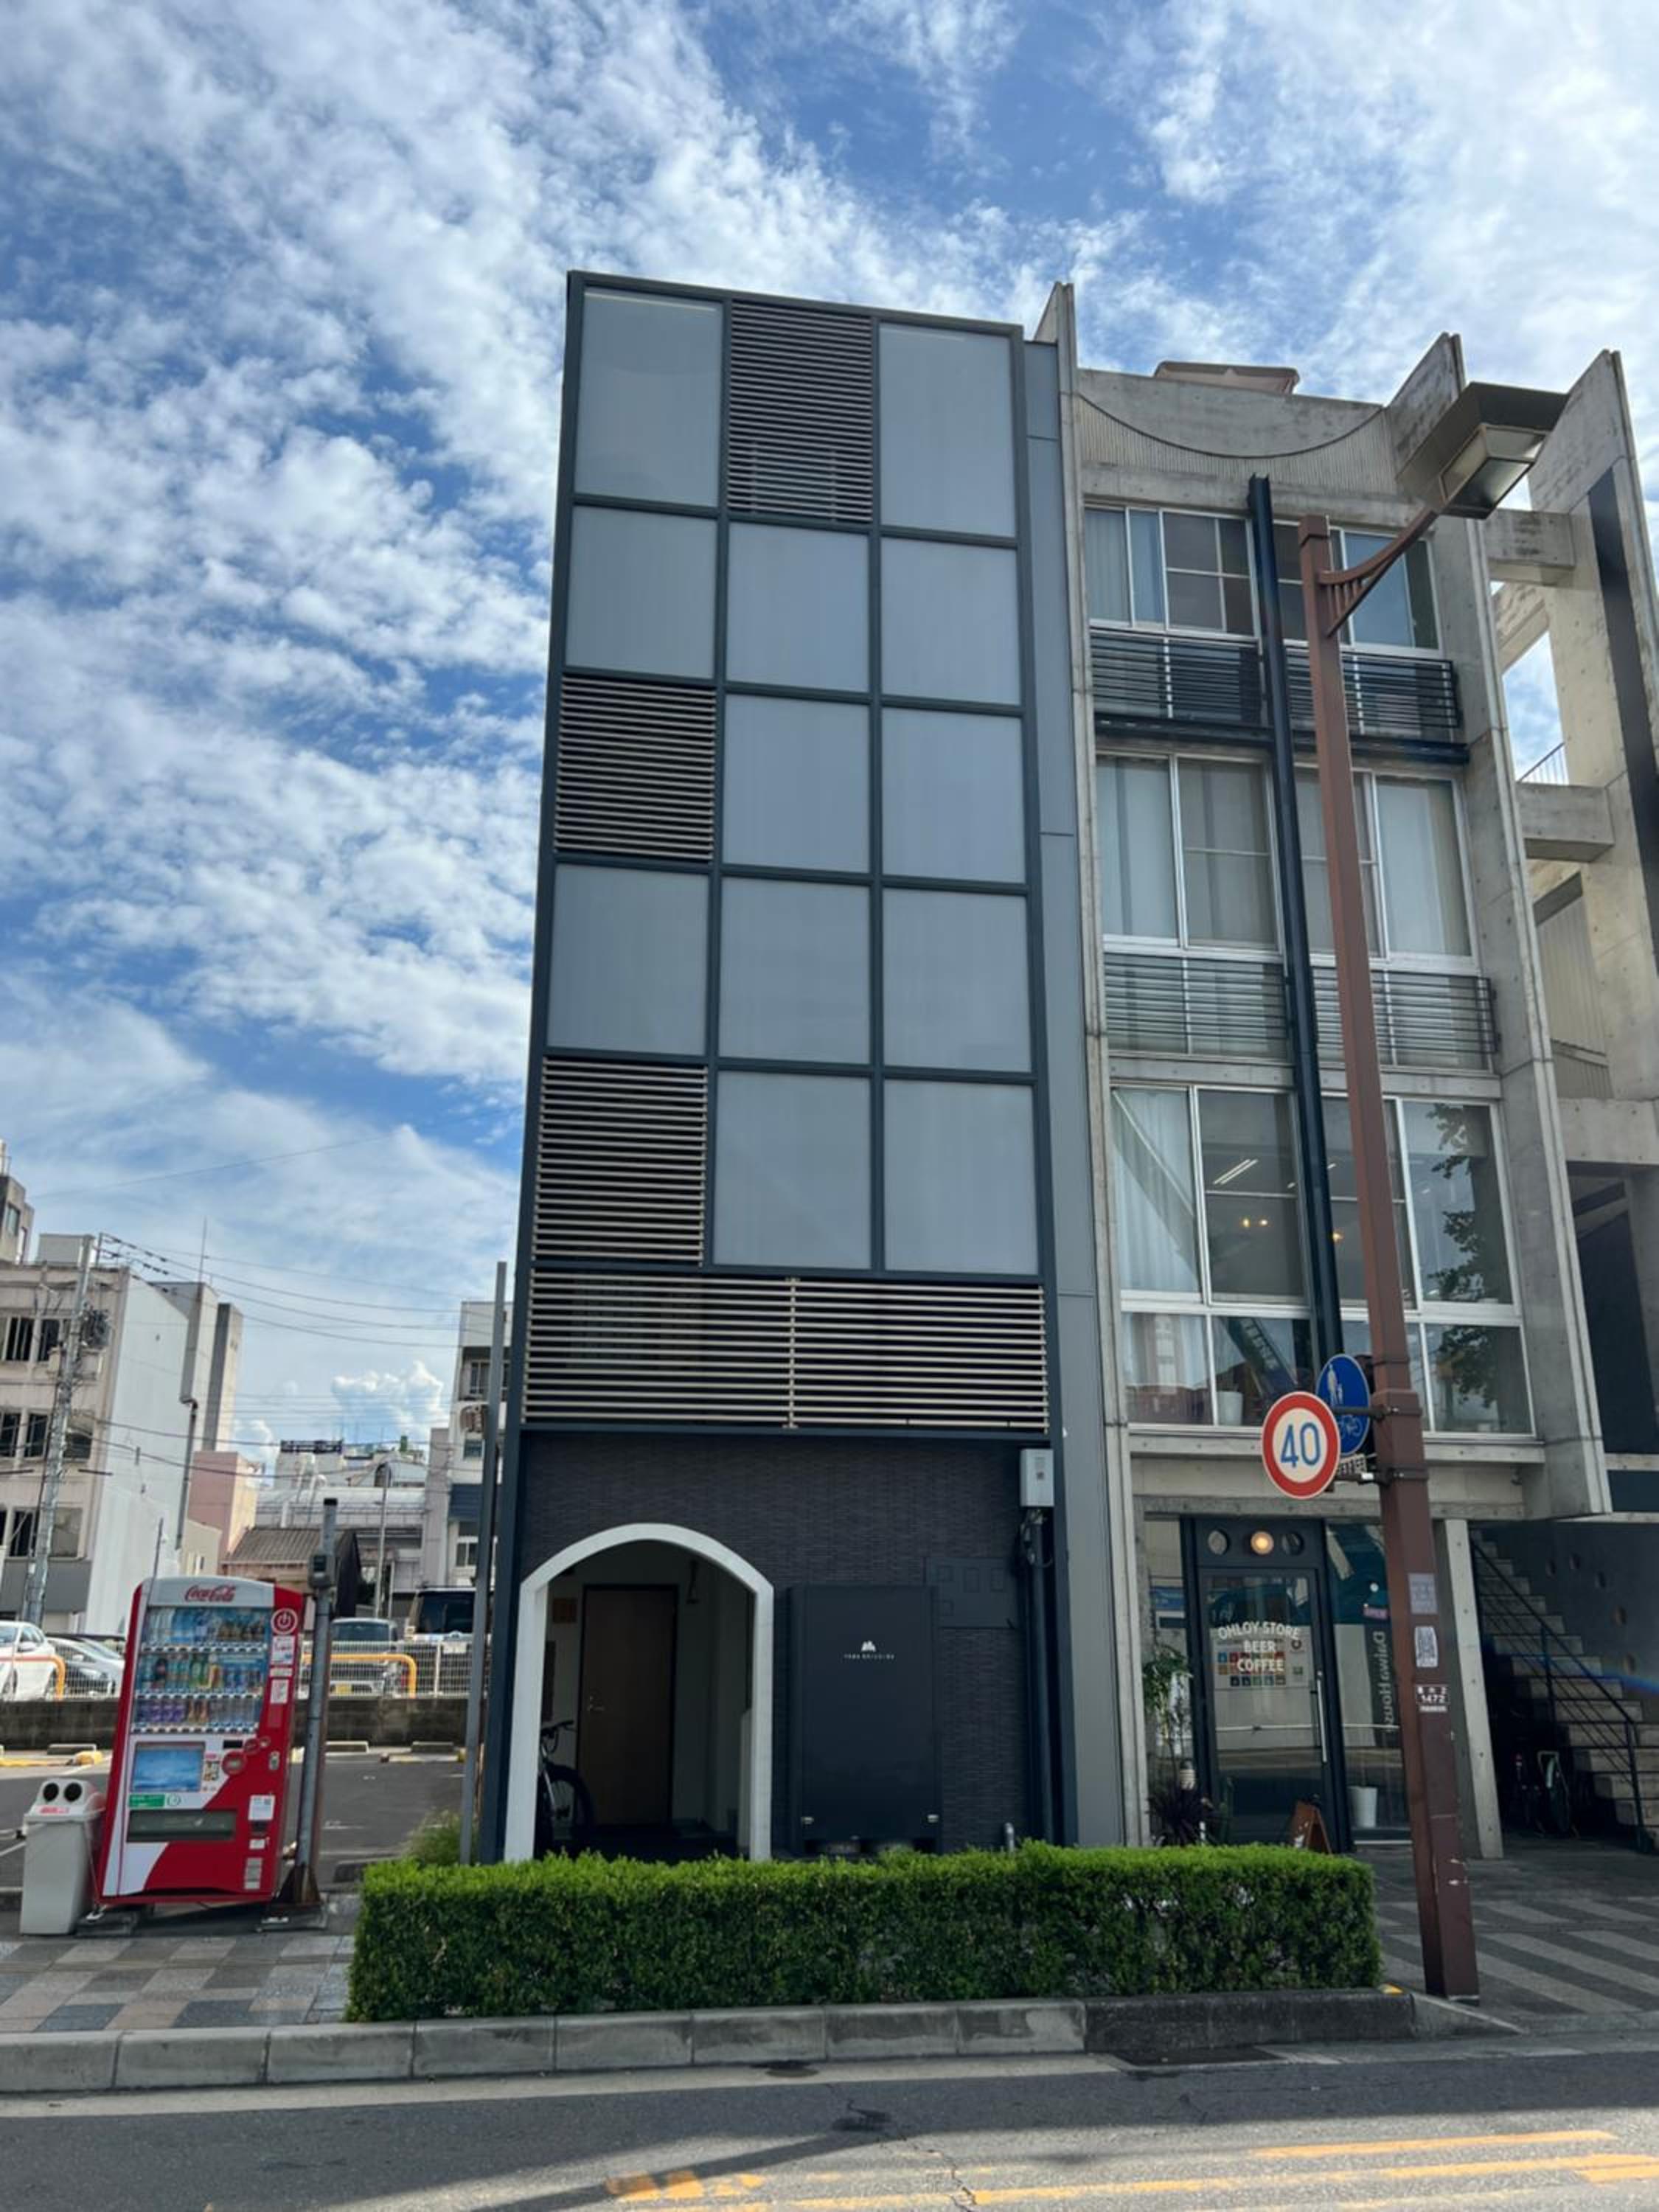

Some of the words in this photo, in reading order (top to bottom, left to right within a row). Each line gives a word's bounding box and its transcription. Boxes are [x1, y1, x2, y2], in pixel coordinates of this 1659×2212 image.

[1281, 1422, 1321, 1468] 40
[1262, 1621, 1300, 1640] STORE
[1244, 1640, 1276, 1653] BEER
[1237, 1658, 1284, 1672] COFFEE
